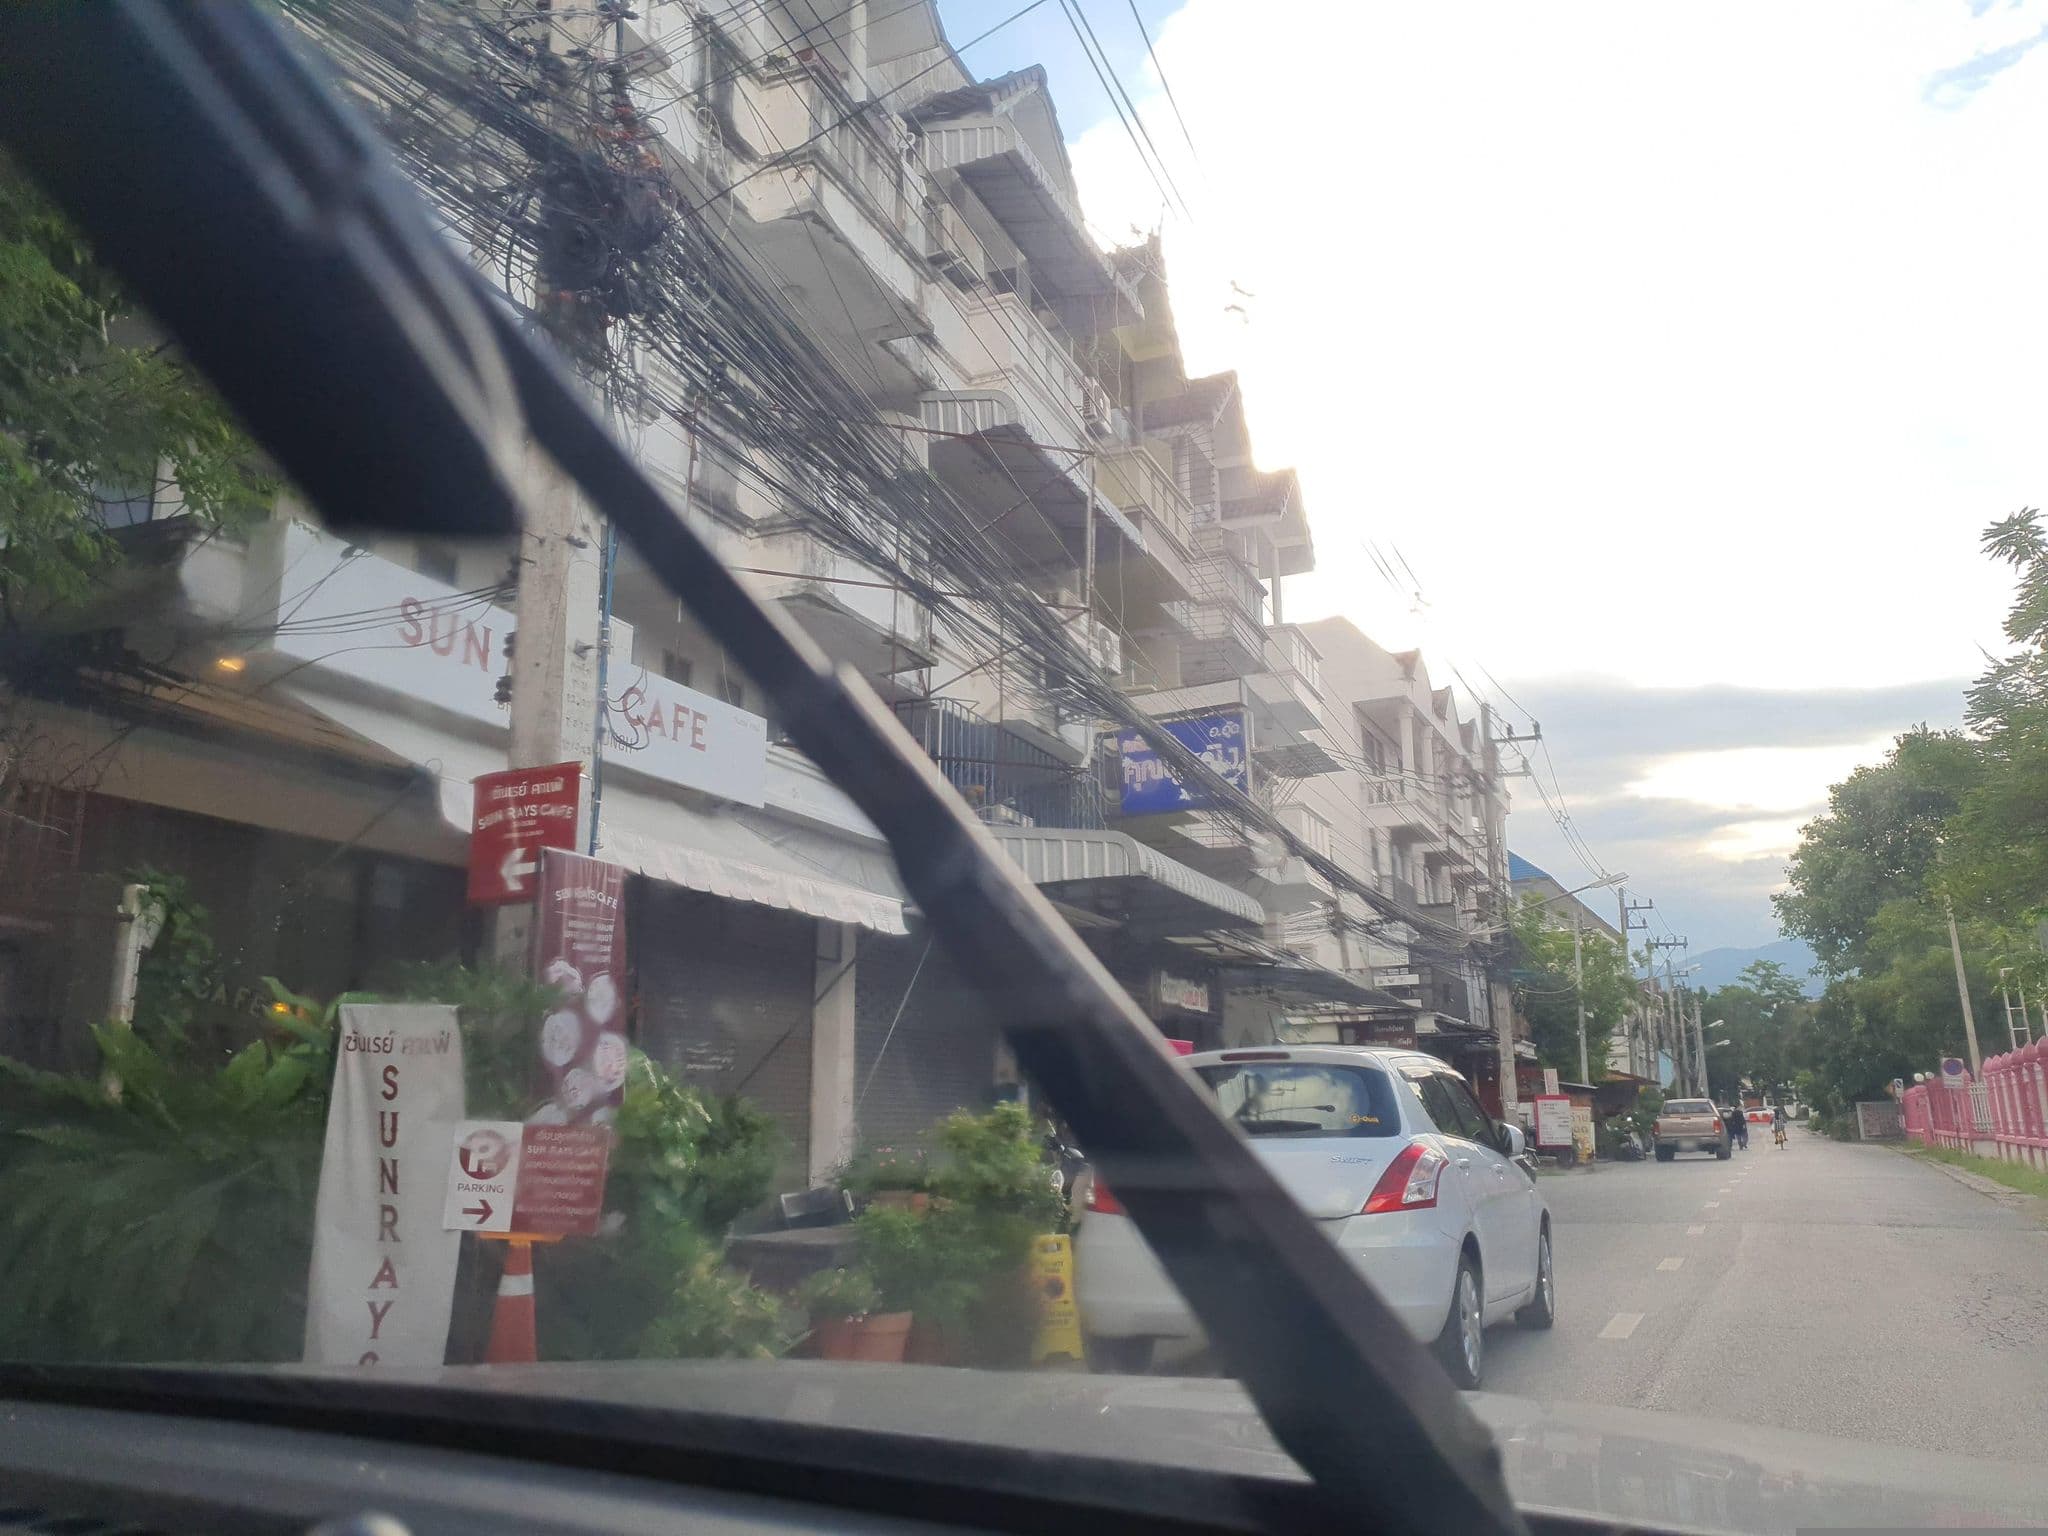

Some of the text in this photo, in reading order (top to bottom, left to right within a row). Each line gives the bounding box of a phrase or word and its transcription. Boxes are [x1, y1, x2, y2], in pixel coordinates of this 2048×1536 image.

[398, 596, 494, 673] SUN
[622, 686, 707, 752] CAFE
[457, 1182, 505, 1194] PARKING
